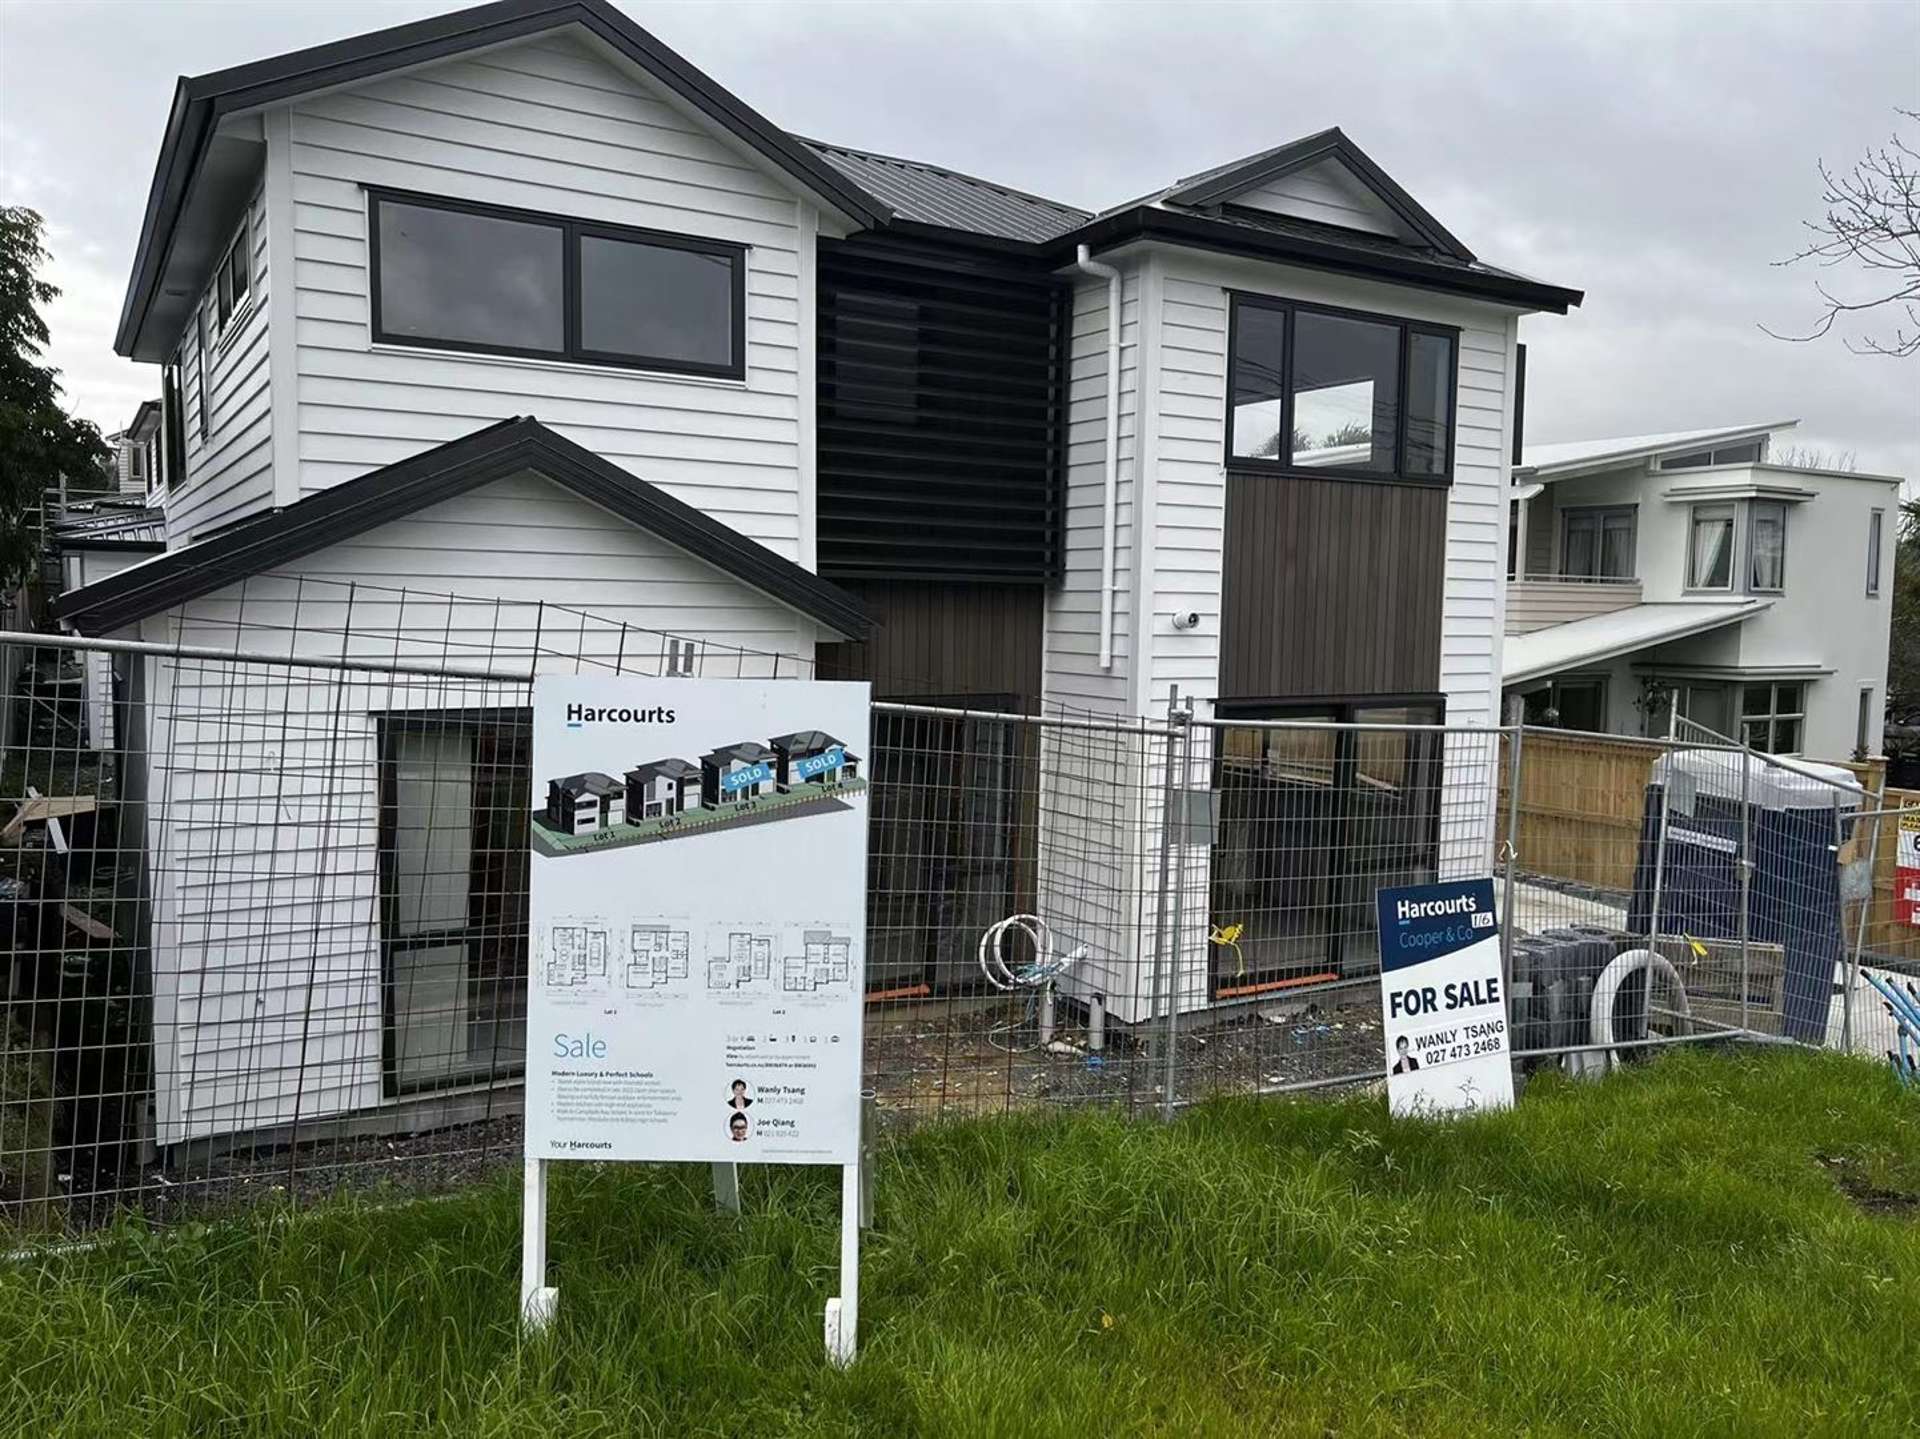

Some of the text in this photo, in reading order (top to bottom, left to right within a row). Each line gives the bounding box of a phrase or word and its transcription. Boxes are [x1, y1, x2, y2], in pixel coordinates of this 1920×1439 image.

[566, 703, 676, 725] Harcourts
[805, 755, 837, 773] SOLD
[730, 768, 763, 786] SOLD
[593, 831, 609, 841] Lot
[1396, 895, 1477, 920] Harcourts
[1399, 924, 1474, 950] Cooper & Co
[1389, 977, 1501, 1019] FOR SALE
[553, 1033, 607, 1059] Sale
[1415, 1019, 1505, 1051] WANLY TSANG
[1426, 1037, 1501, 1066] 027 473 2468
[757, 1086, 806, 1095] Wanly Tsang
[772, 1119, 796, 1128] Qiang
[550, 1140, 612, 1150] Your Harcourts
